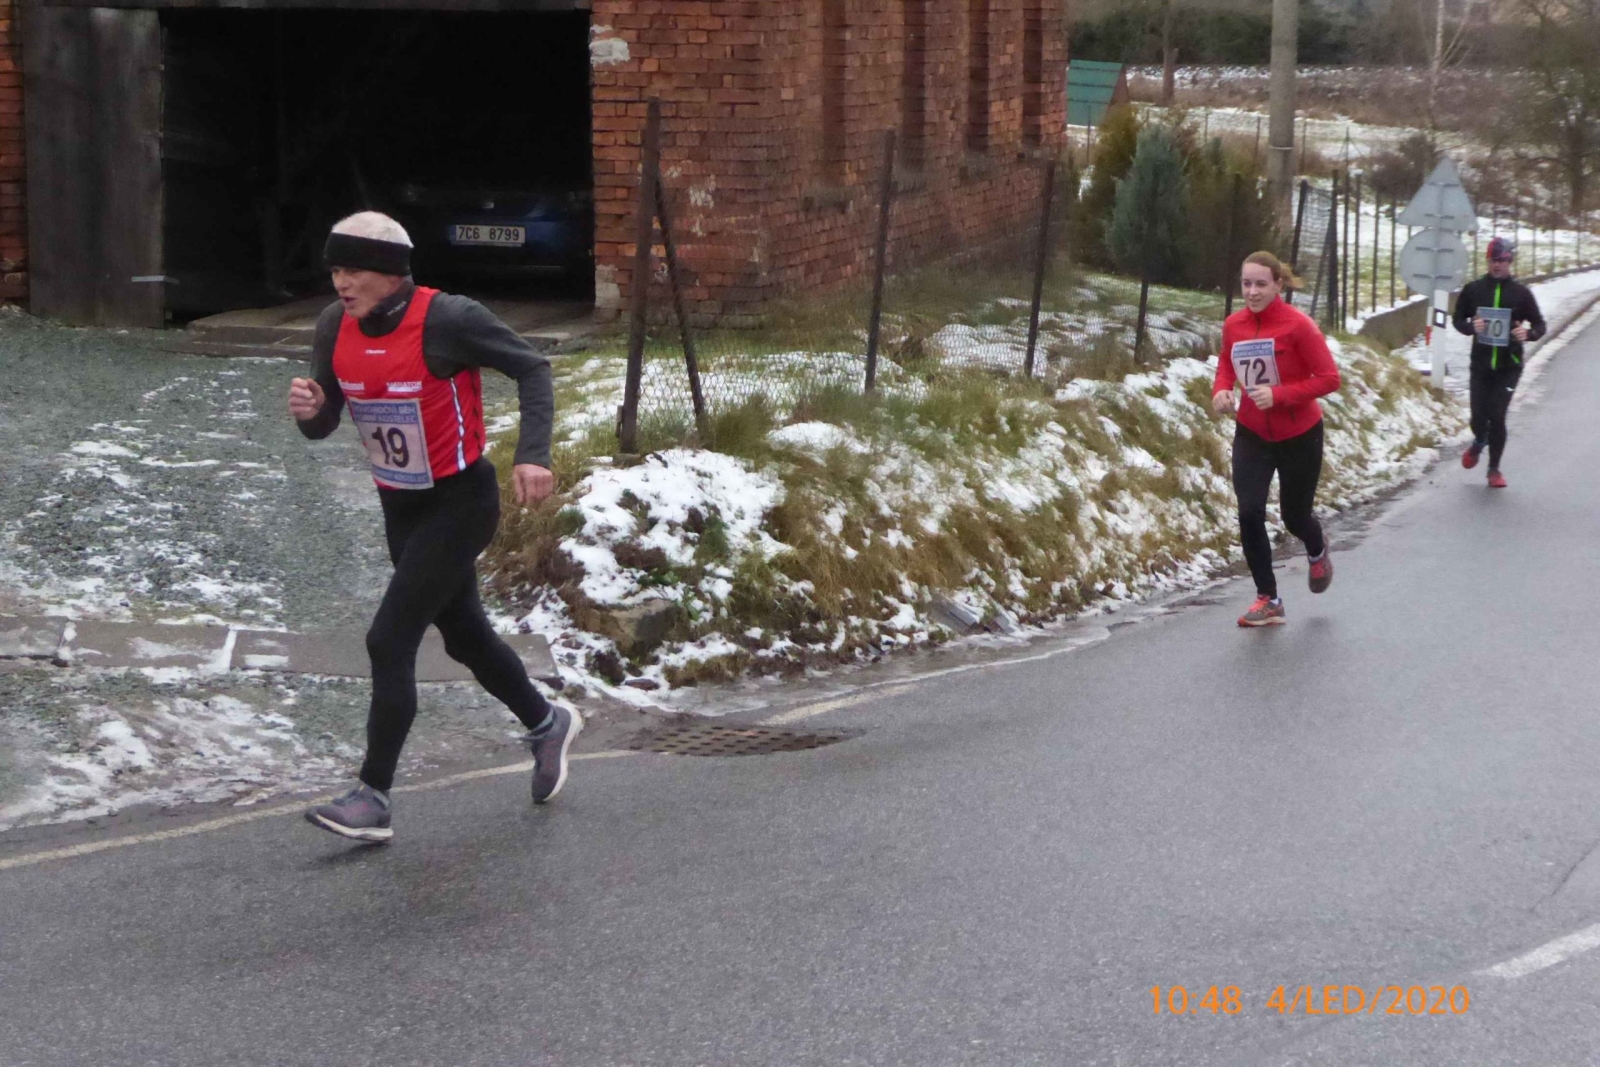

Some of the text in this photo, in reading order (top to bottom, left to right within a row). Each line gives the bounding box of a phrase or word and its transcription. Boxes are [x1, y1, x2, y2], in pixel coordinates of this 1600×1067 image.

[459, 227, 519, 241] 7C6 8799
[1239, 358, 1270, 386] 72
[371, 427, 410, 468] 19
